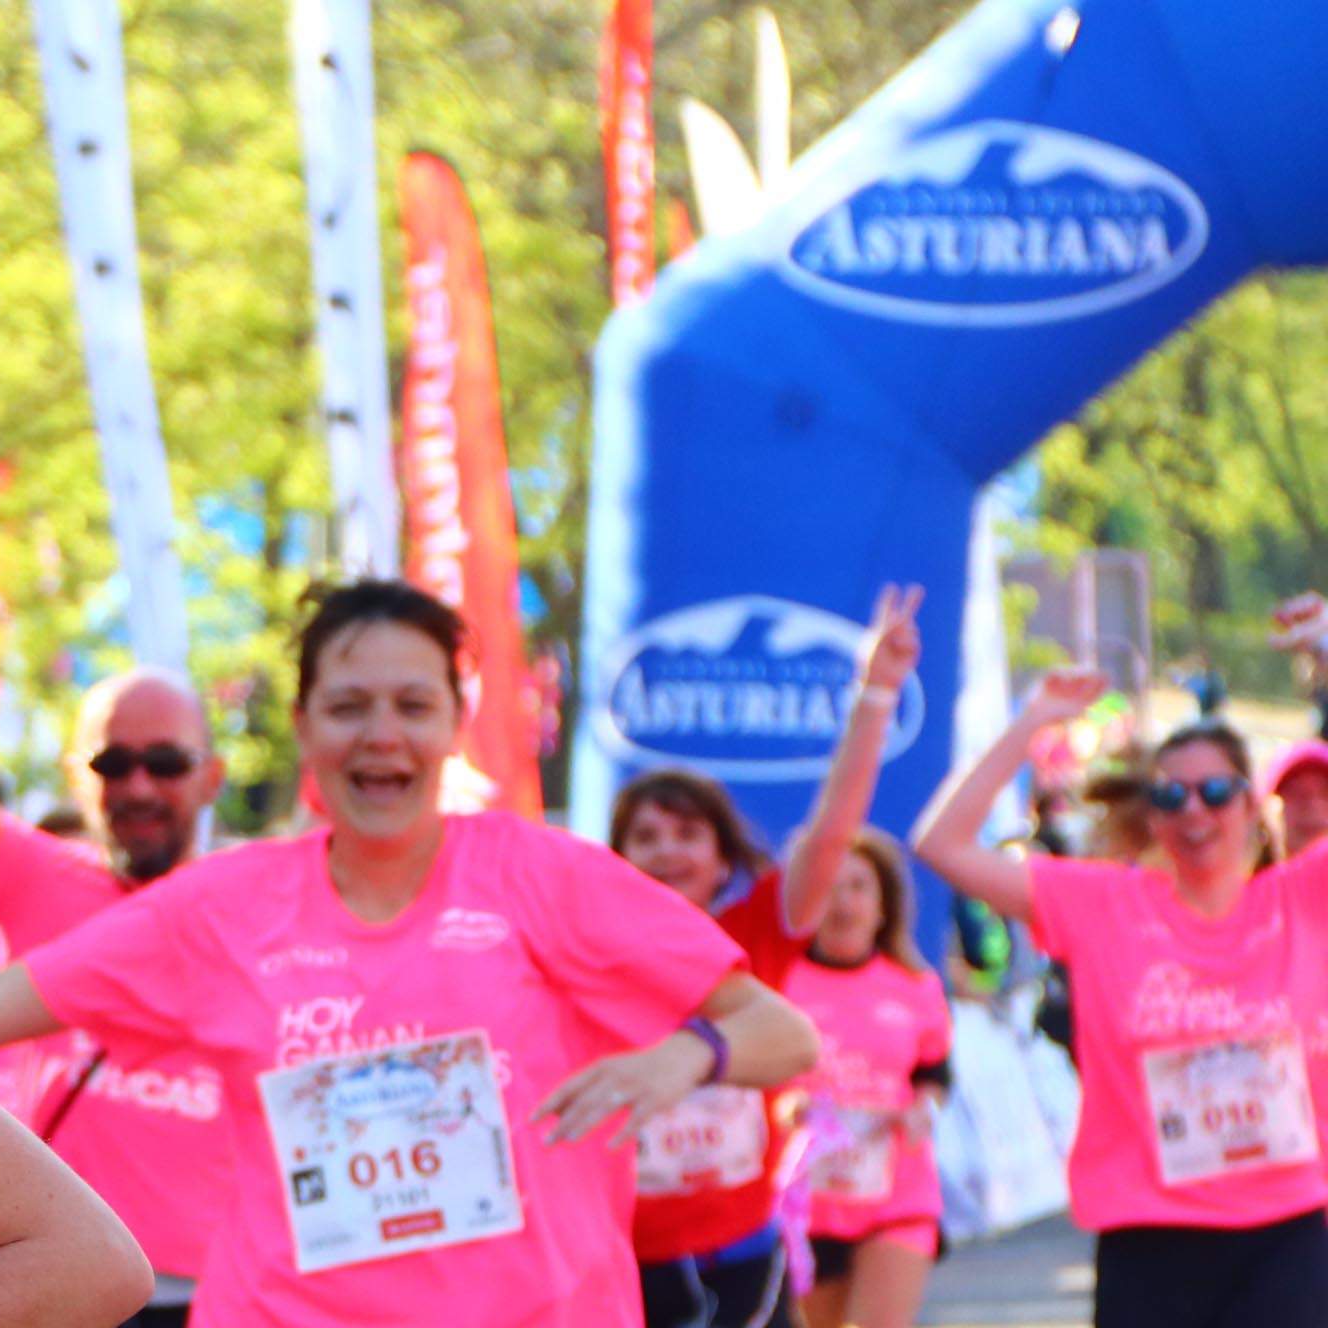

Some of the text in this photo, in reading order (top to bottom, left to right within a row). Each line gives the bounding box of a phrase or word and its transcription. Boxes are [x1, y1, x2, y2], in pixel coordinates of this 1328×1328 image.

[798, 202, 1174, 277] ASTURIANA
[277, 996, 365, 1037] HOY
[348, 1139, 442, 1188] 016
